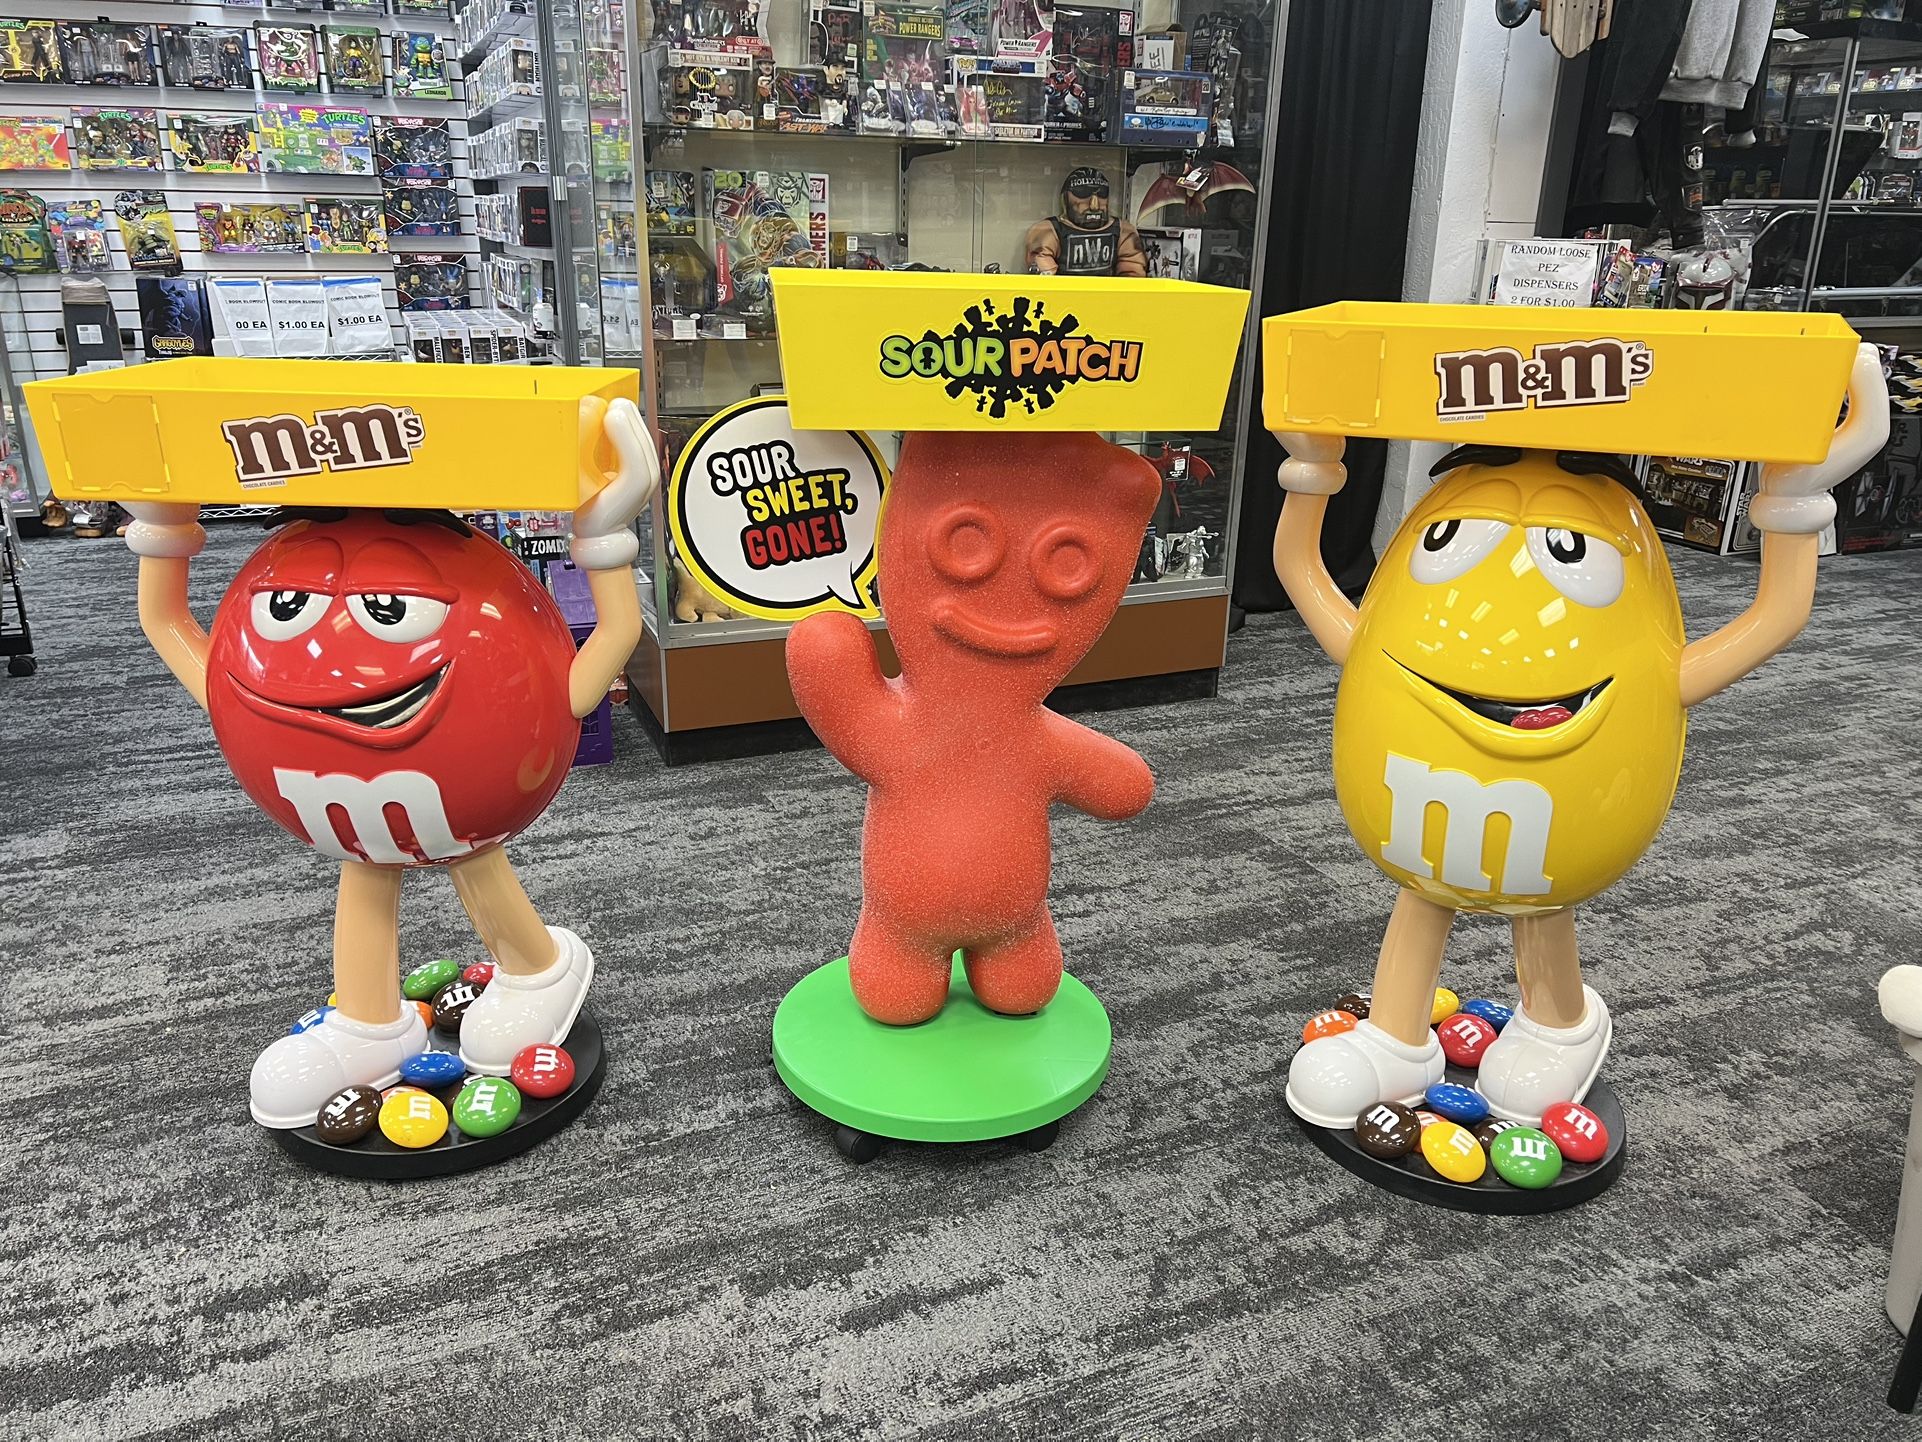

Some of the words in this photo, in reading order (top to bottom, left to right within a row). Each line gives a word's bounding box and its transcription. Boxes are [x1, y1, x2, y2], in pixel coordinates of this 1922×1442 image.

[899, 22, 918, 34] POWER
[918, 24, 941, 37] RANGERS
[98, 111, 133, 122] TURTLES
[322, 112, 366, 125] TURTLES
[1073, 238, 1109, 263] nWo
[1511, 245, 1556, 256] RANDOM
[1560, 247, 1591, 258] LOOSE
[1538, 263, 1559, 272] PEZ
[1513, 279, 1579, 291] DISPENSERS
[1511, 295, 1517, 304] 2
[1521, 297, 1541, 305] FOR
[1544, 297, 1575, 308] $1.00
[252, 321, 268, 329] EA
[279, 321, 308, 329] $1.00
[311, 321, 325, 329] EA
[338, 316, 365, 326] $1.00
[368, 314, 382, 323] EA
[153, 336, 194, 350] GARGOYLES
[518, 337, 526, 359] BATGIR
[881, 336, 1003, 378] SOUR
[1008, 338, 1141, 380] PATCH
[712, 445, 796, 492] SOUR
[243, 481, 267, 489] CHOCOLATE
[746, 473, 853, 522] SWEET,
[745, 513, 843, 566] GONE!
[272, 766, 474, 864] m
[1380, 752, 1553, 895] m
[1313, 1011, 1343, 1028] m
[1452, 1019, 1483, 1048] m
[533, 1047, 559, 1072] m
[325, 1088, 361, 1116] m
[409, 1095, 431, 1120] m
[468, 1082, 499, 1116] m
[1366, 1104, 1400, 1133] m
[1564, 1108, 1598, 1140] m
[1448, 1129, 1477, 1156] m
[1510, 1136, 1549, 1160] m
